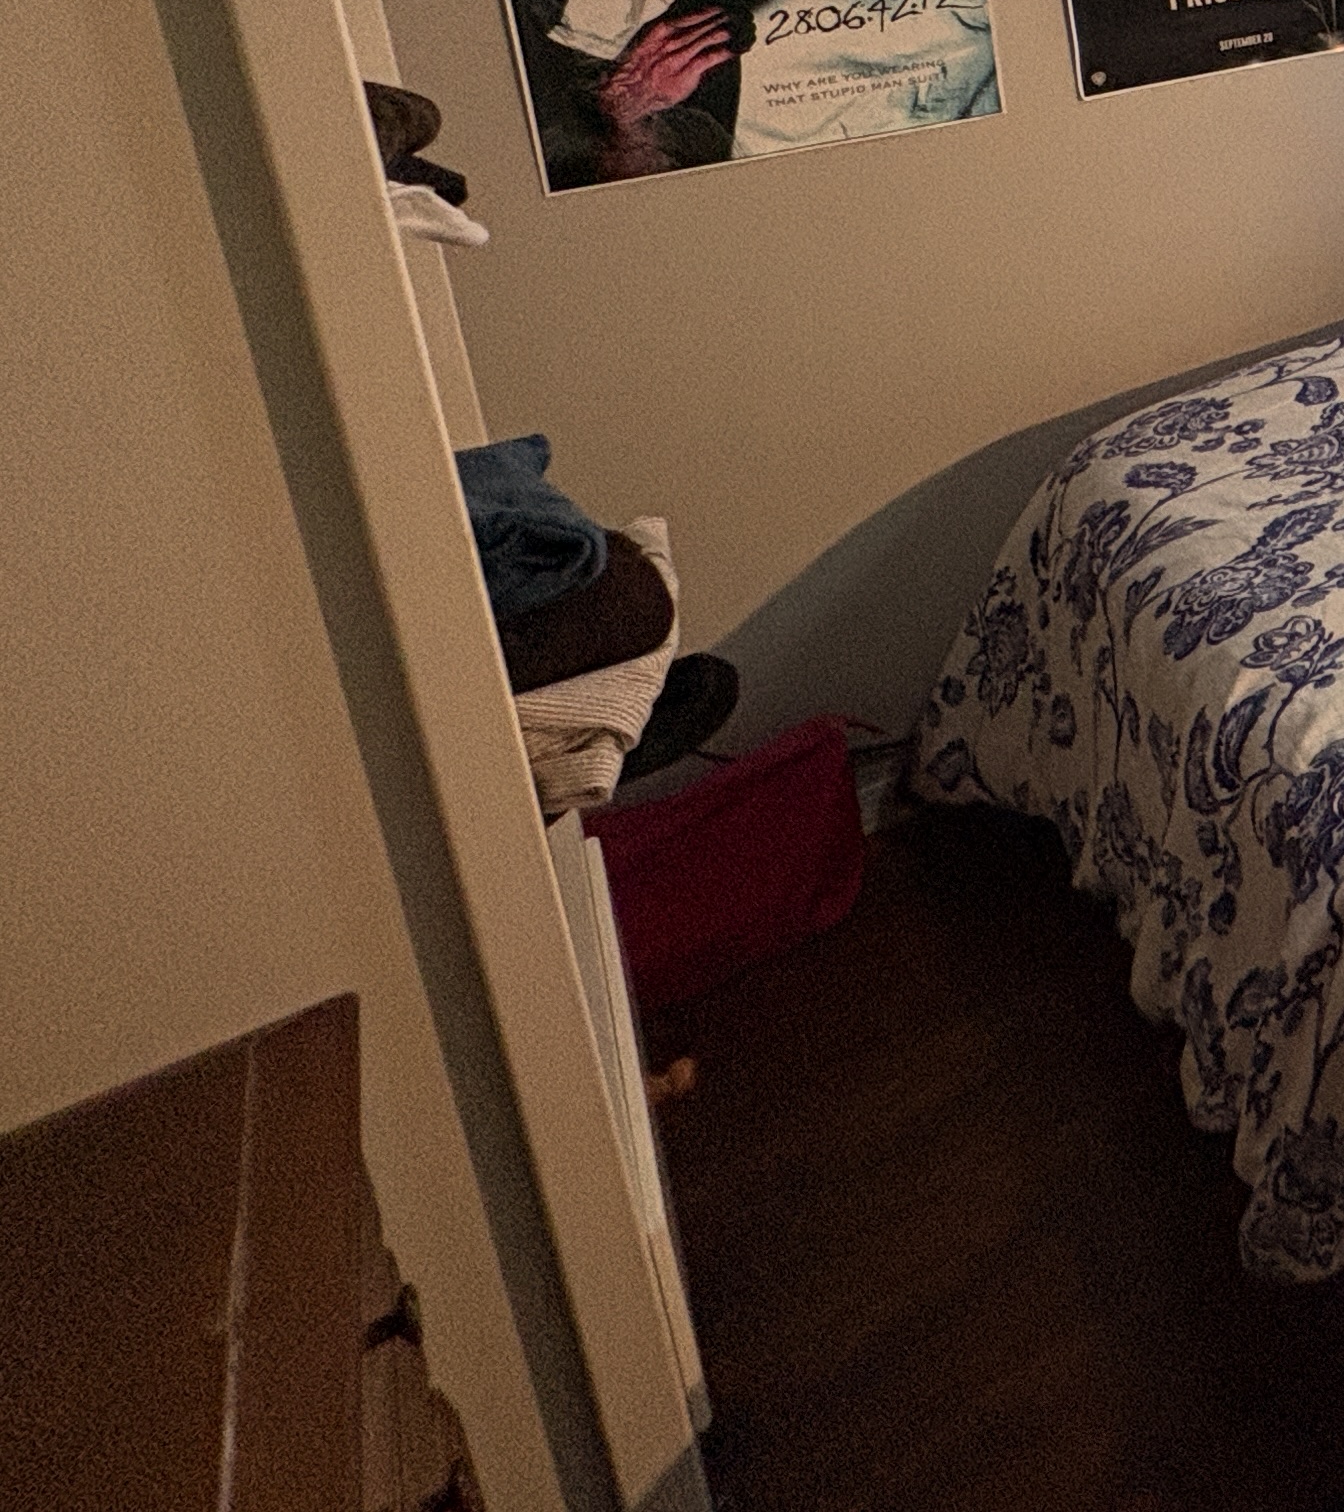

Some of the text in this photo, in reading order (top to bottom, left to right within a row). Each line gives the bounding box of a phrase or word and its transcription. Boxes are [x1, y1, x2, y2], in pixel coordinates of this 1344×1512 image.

[763, 80, 801, 95] WHY
[807, 74, 838, 88] ARE
[841, 69, 876, 84] YOU
[766, 94, 808, 108] THAT
[811, 85, 867, 102] STUPID
[871, 78, 903, 93] MAN
